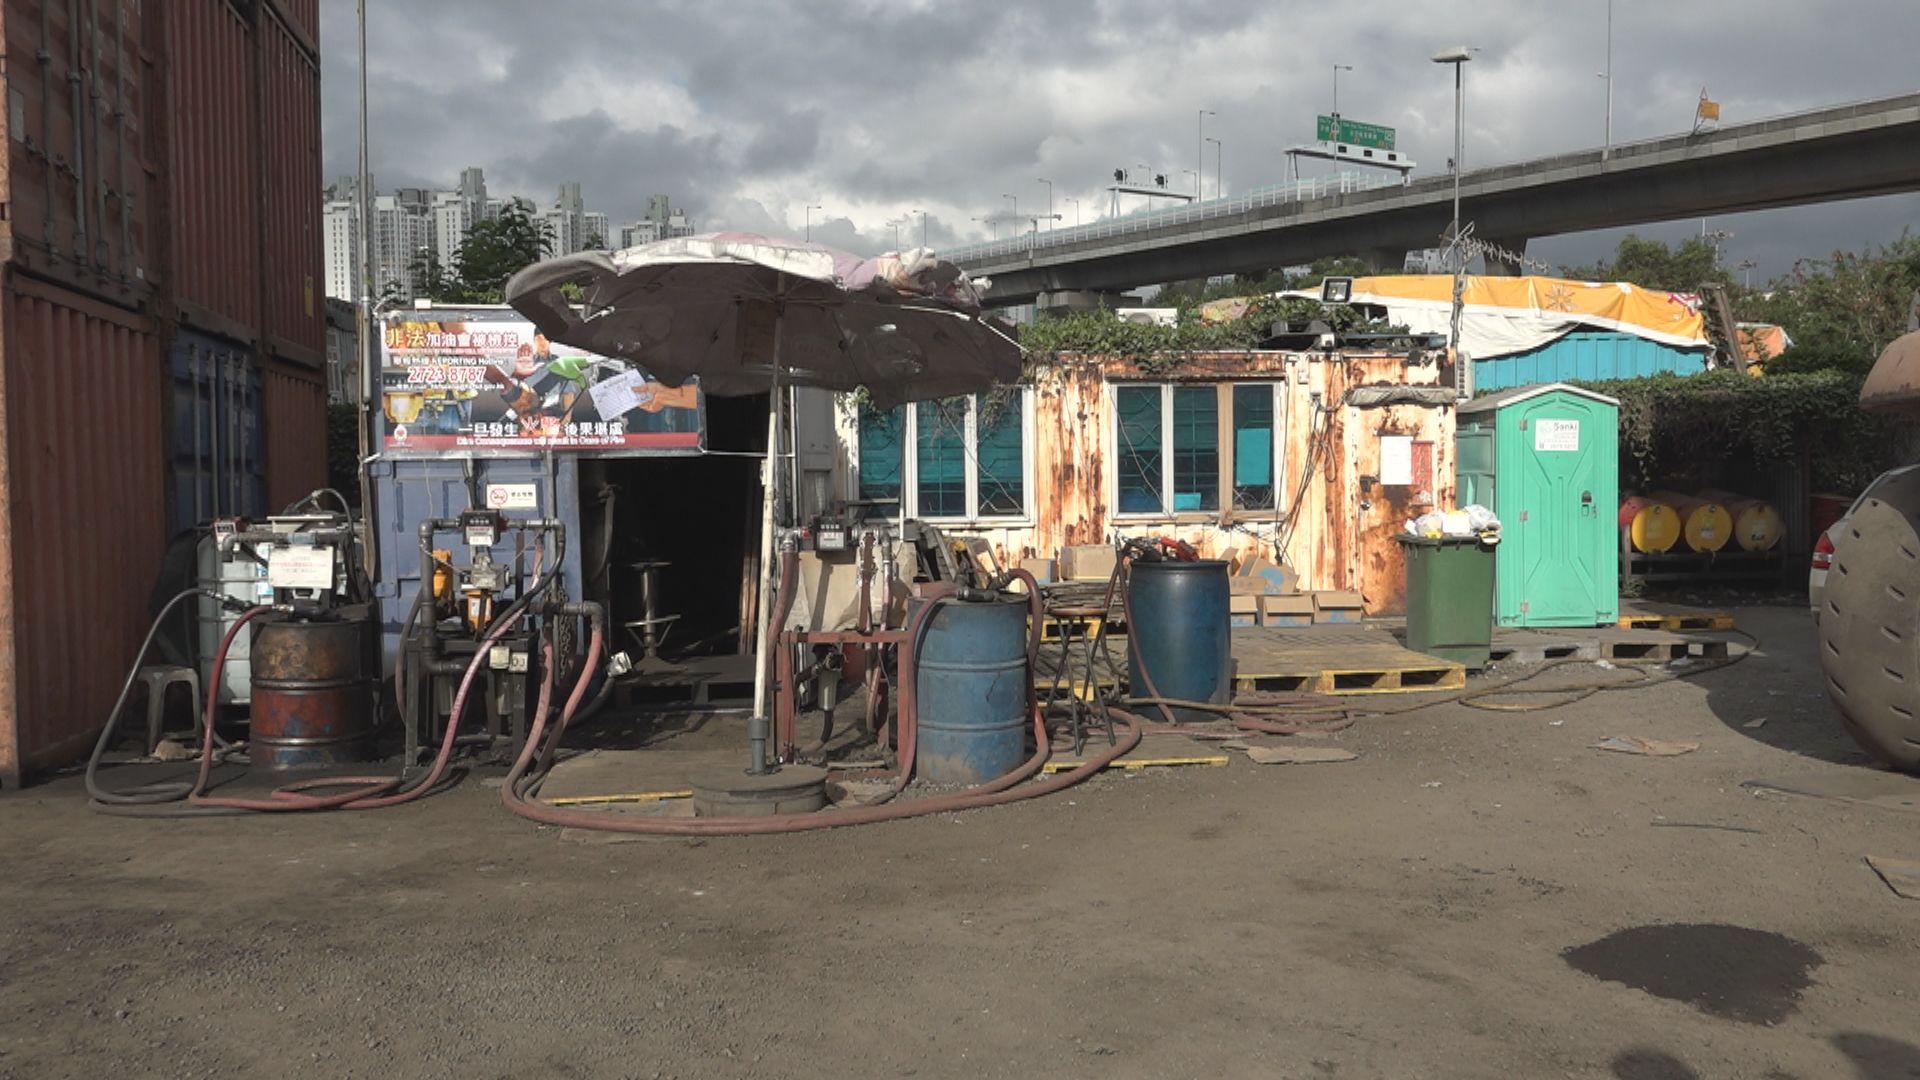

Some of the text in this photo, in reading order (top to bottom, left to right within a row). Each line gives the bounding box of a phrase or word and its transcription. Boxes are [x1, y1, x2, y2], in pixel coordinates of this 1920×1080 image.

[386, 328, 519, 348] 非法加油會被檢控
[432, 357, 477, 366] REPORTING
[408, 366, 486, 383] 2723 8787
